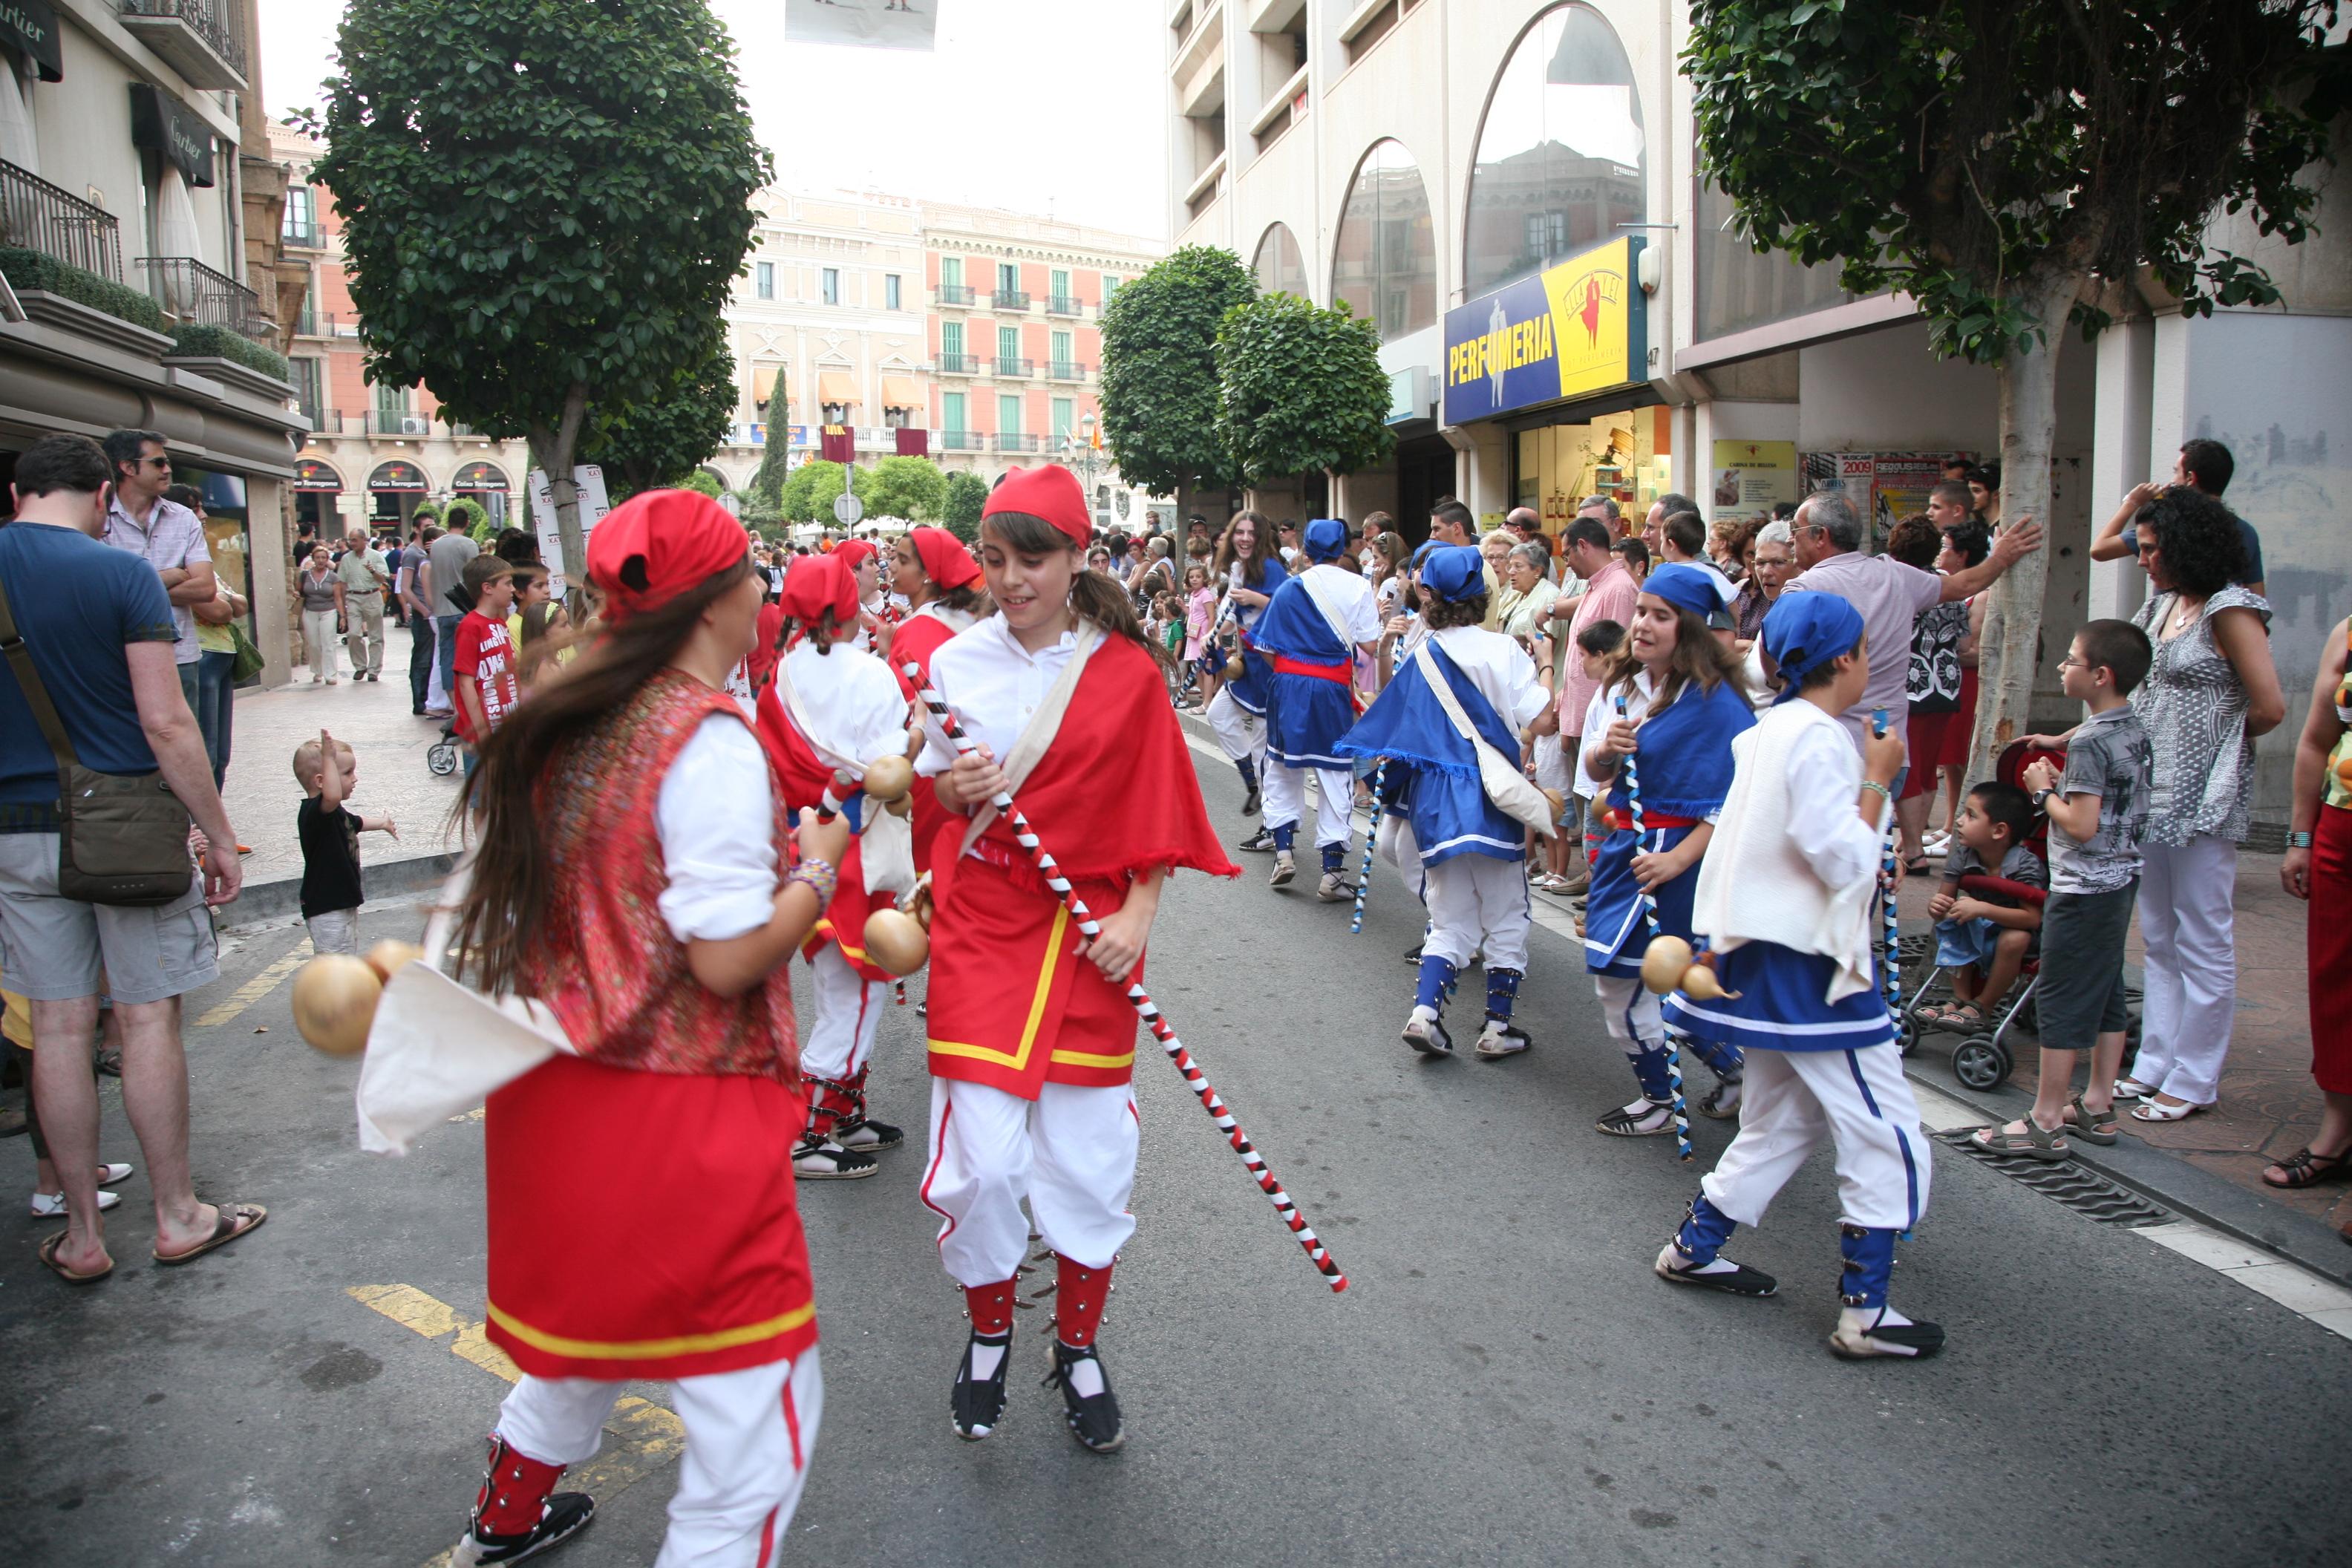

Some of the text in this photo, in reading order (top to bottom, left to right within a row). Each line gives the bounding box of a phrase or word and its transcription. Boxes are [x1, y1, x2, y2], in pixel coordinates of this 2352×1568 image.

[172, 116, 202, 160] Cartier
[1449, 313, 1552, 387] PERFUMERIA
[1647, 347, 1659, 366] 47
[1843, 461, 1872, 474] 2009
[302, 480, 339, 488] Tarragona
